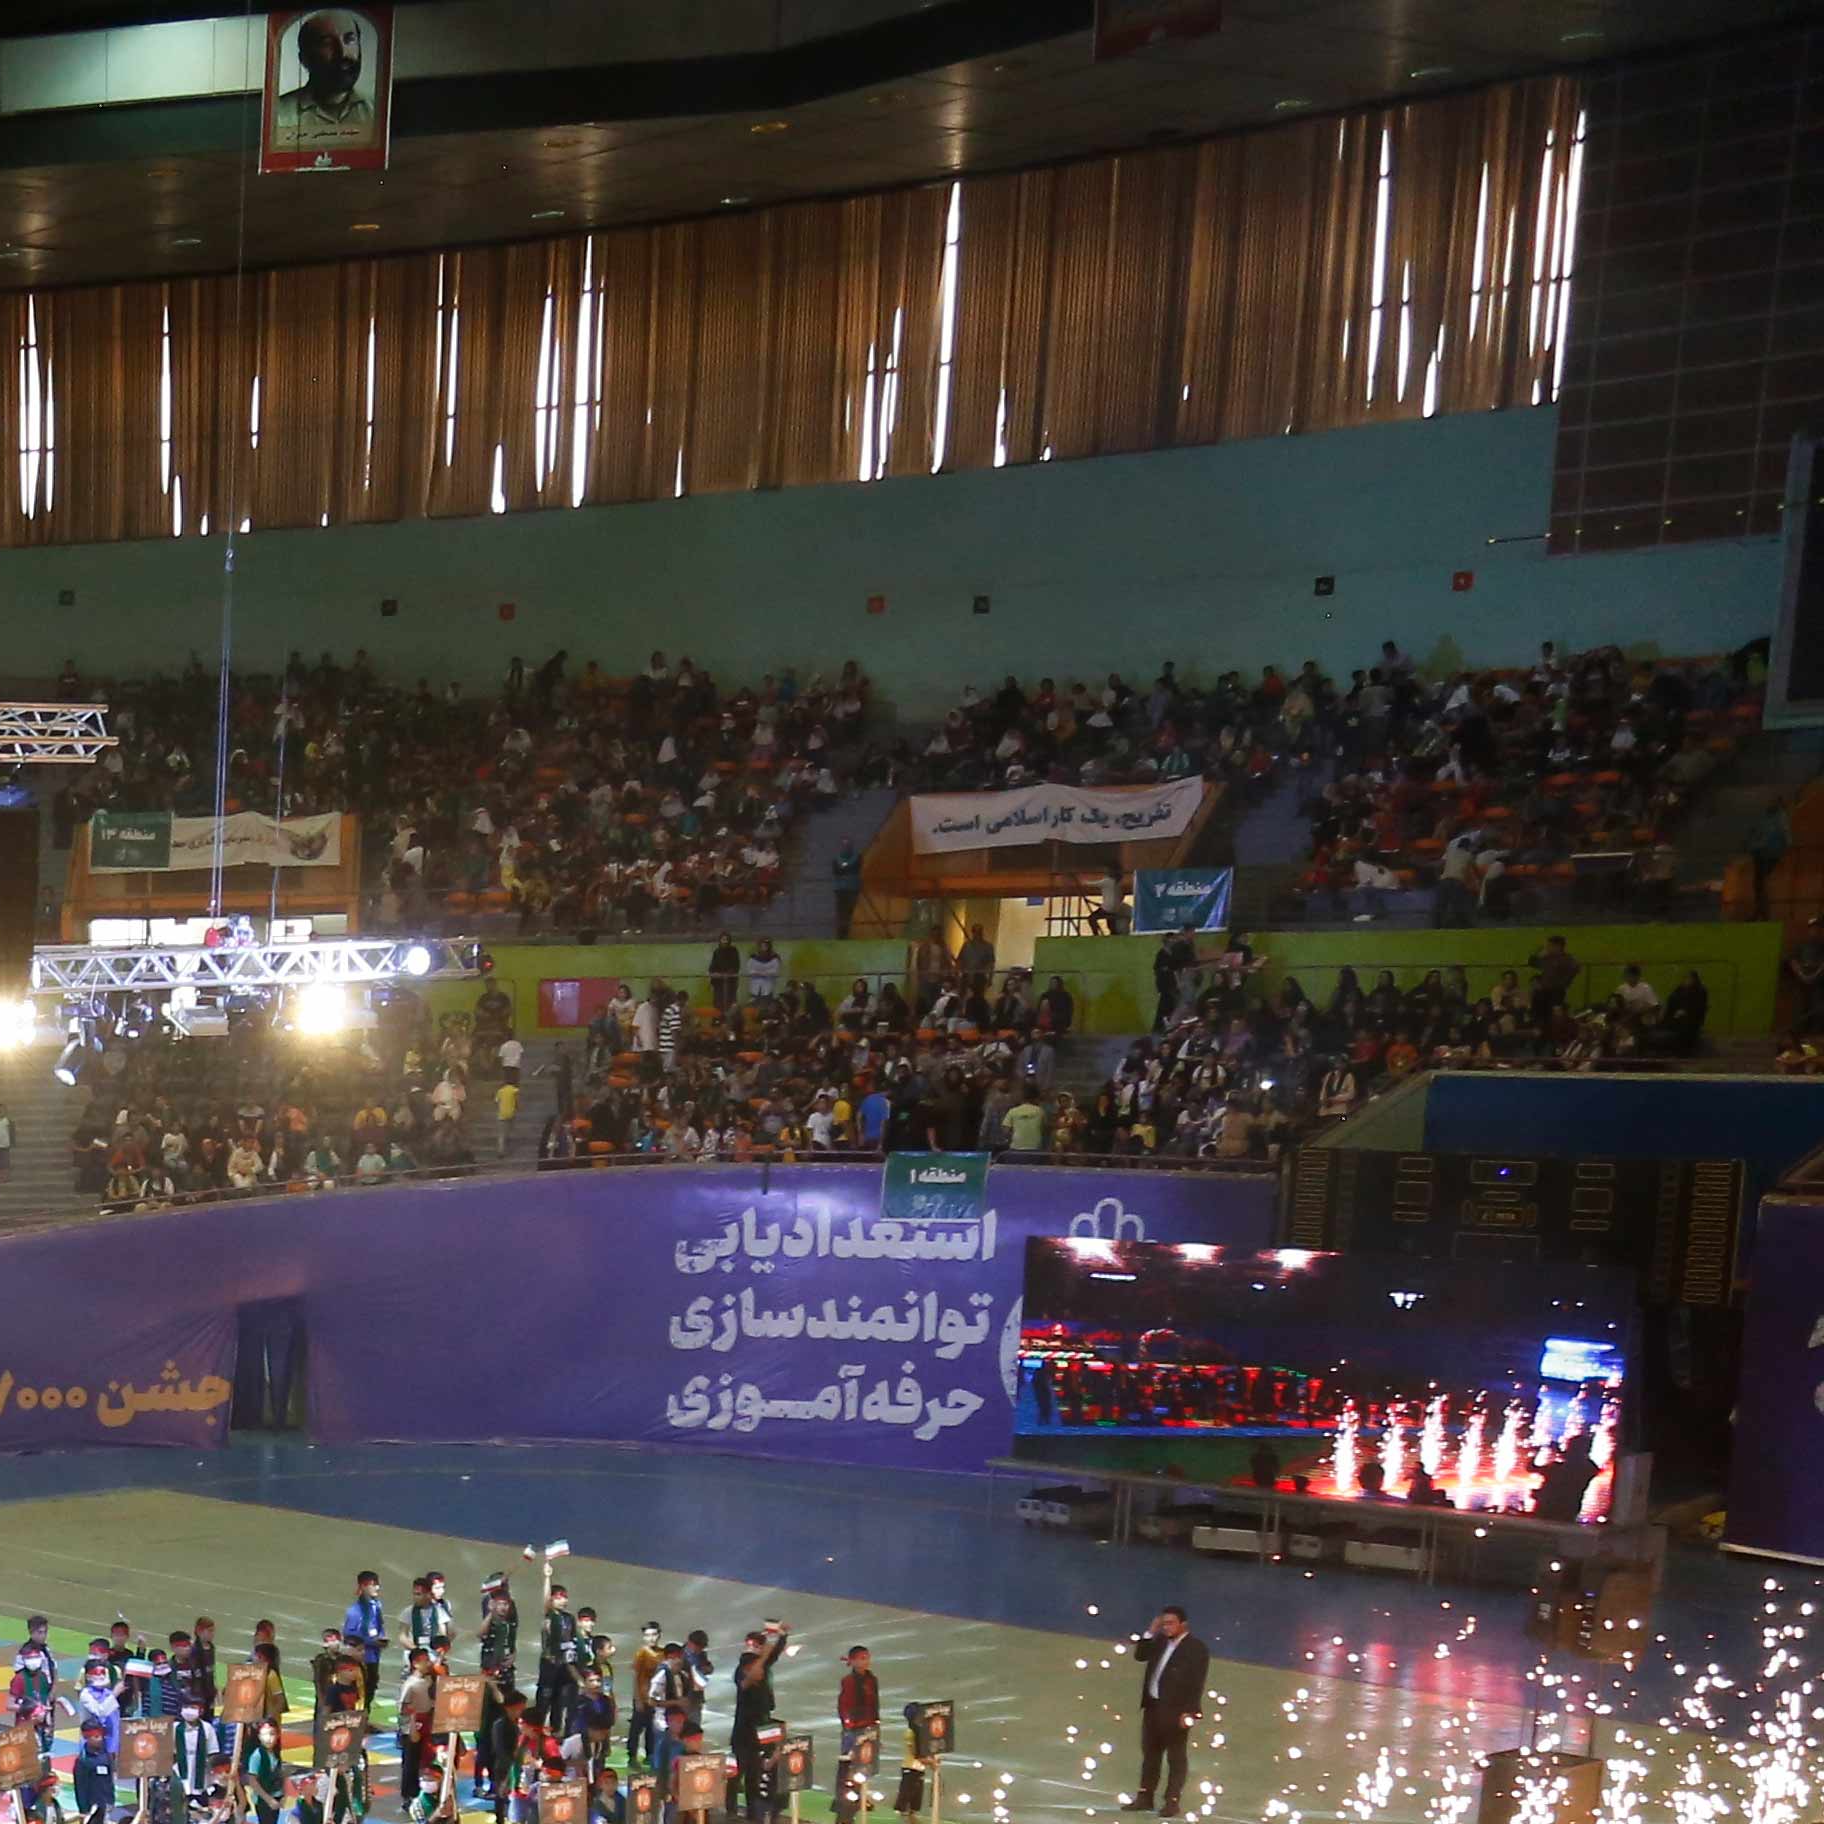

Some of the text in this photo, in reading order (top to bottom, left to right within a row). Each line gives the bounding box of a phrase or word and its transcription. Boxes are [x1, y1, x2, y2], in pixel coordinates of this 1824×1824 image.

[985, 807, 1049, 835] اسلامی
[1168, 881, 1212, 897] منطقه
[910, 1167, 967, 1185] منطقه ۱
[674, 1207, 997, 1275] استعدادیابی
[668, 1286, 994, 1362] توانمندسازی
[95, 1359, 232, 1428] جشن
